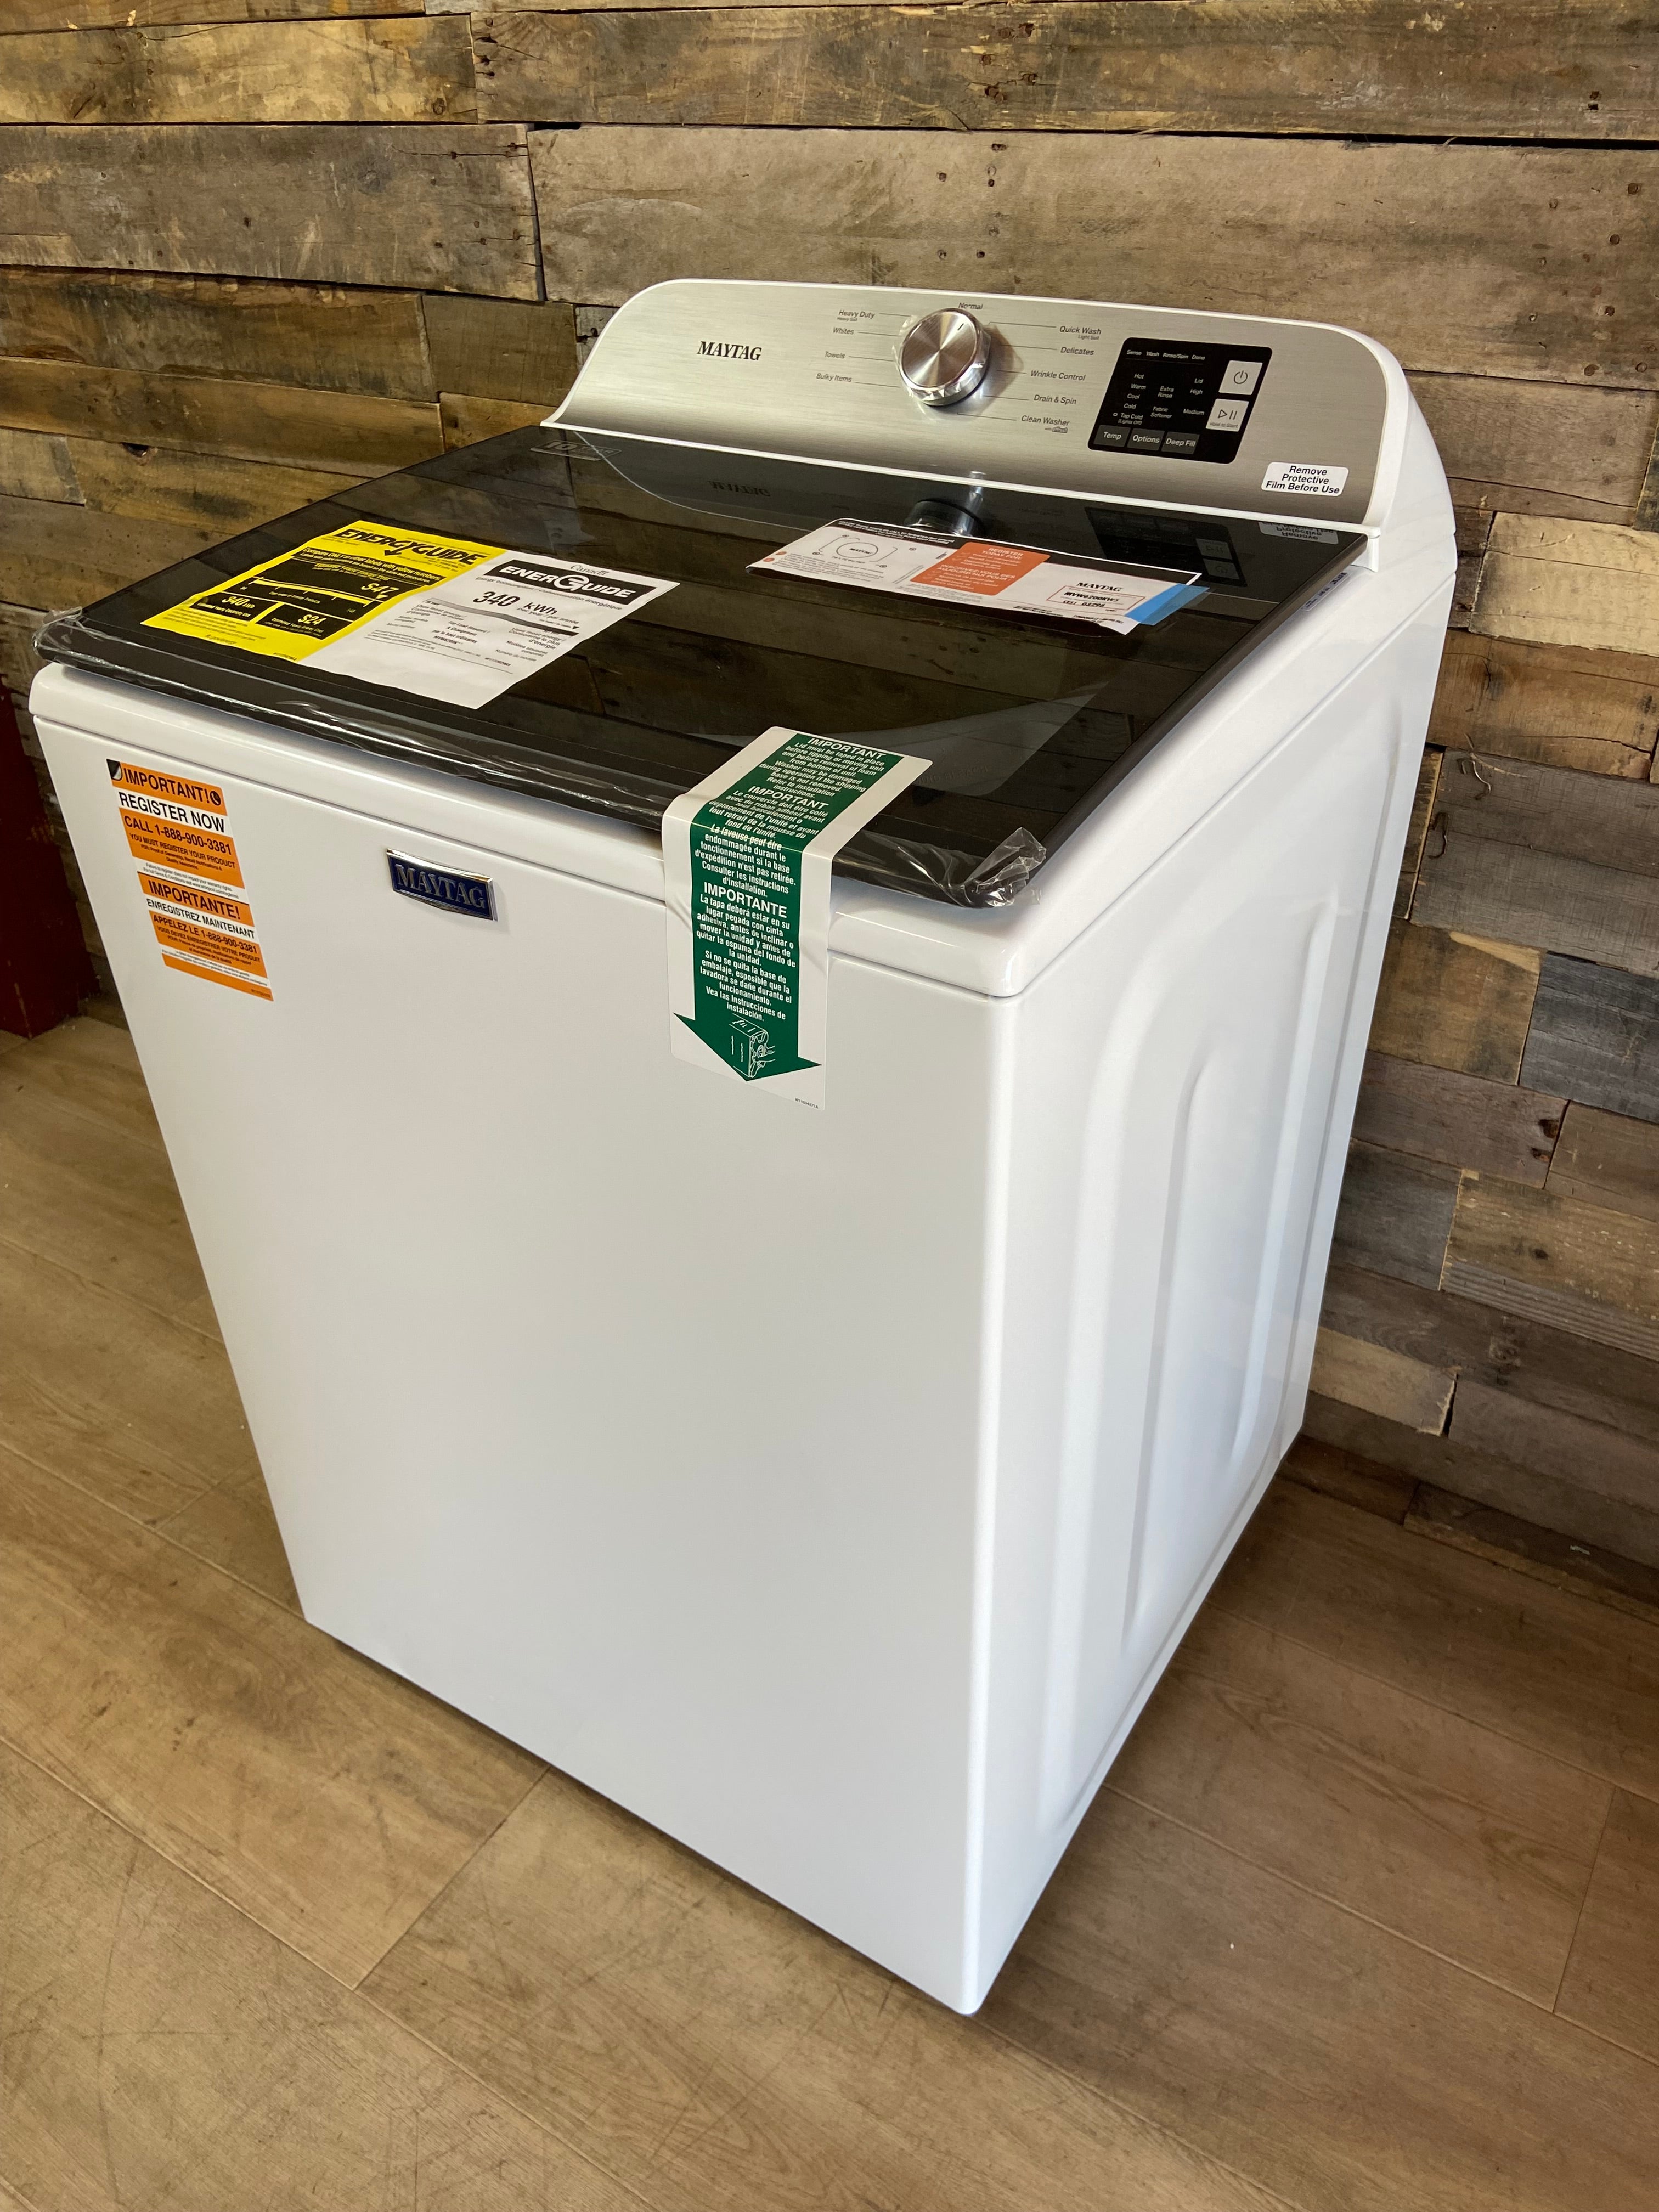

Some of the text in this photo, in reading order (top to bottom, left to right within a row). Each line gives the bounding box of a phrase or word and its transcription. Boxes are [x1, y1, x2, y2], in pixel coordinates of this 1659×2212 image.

[839, 310, 875, 319] Heavy Duty
[697, 341, 762, 360] MAYTAG
[1061, 347, 1094, 355] Delicates
[816, 373, 834, 382] Bulky
[1059, 373, 1085, 381] Control
[1034, 394, 1052, 403] Drain
[1061, 397, 1076, 405] Spin
[1043, 417, 1069, 426] Washer
[1104, 432, 1121, 440] Temp
[1133, 435, 1160, 444] Options
[1282, 474, 1329, 484] Protective
[1289, 466, 1327, 475] Remove
[1288, 483, 1318, 492] Before
[1322, 486, 1340, 494] Use
[334, 528, 487, 565] ENERGYGUIDE
[982, 550, 1006, 558] TODAY
[989, 548, 1023, 556] REGISTER
[361, 583, 399, 595] $47
[1077, 582, 1122, 591] MAYTAG
[473, 591, 557, 614] 340 kWh
[298, 614, 326, 625] $24
[808, 738, 886, 759] IMPORTANT
[836, 752, 855, 760] taped
[124, 768, 210, 803] IMPORTANT!
[743, 793, 778, 805] couvercle
[778, 801, 793, 810] doit
[794, 804, 809, 812] être
[810, 809, 828, 817] collé
[748, 786, 829, 810] IMPORTANT
[119, 792, 224, 833] REGISTER NOW
[709, 806, 724, 816] tout
[725, 811, 747, 822] retrait
[767, 824, 795, 836] mousse
[125, 815, 232, 855] CALL 1-888-900-3381
[130, 833, 235, 869] YOU MUST REGISTER YOUR PRODUCT
[395, 864, 486, 909] MAYTAG
[702, 860, 789, 894] Consulter les instructions
[723, 877, 768, 897] d'installation.
[148, 879, 240, 919] IMPORTANTE!
[704, 882, 787, 918] IMPORTANTE
[146, 898, 255, 939] ENREGISTREZ MAINTENANT
[701, 894, 708, 904] La
[710, 898, 725, 909] tapa
[727, 903, 750, 917] deberá
[752, 912, 769, 923] estar
[771, 918, 780, 927] en
[706, 906, 783, 936] lugar pegada con cinta
[154, 914, 257, 954] APPELEZ LE 1-888-900-3381
[705, 950, 712, 959] Si
[714, 953, 722, 962] no
[733, 961, 750, 972] quita
[752, 966, 758, 974] la
[760, 968, 776, 980] base
[778, 975, 787, 984] de
[729, 949, 761, 966] la unidad.
[706, 986, 718, 997] Vea
[720, 991, 730, 1001] las
[777, 1011, 786, 1020] de
[727, 1002, 764, 1022] instalación.
